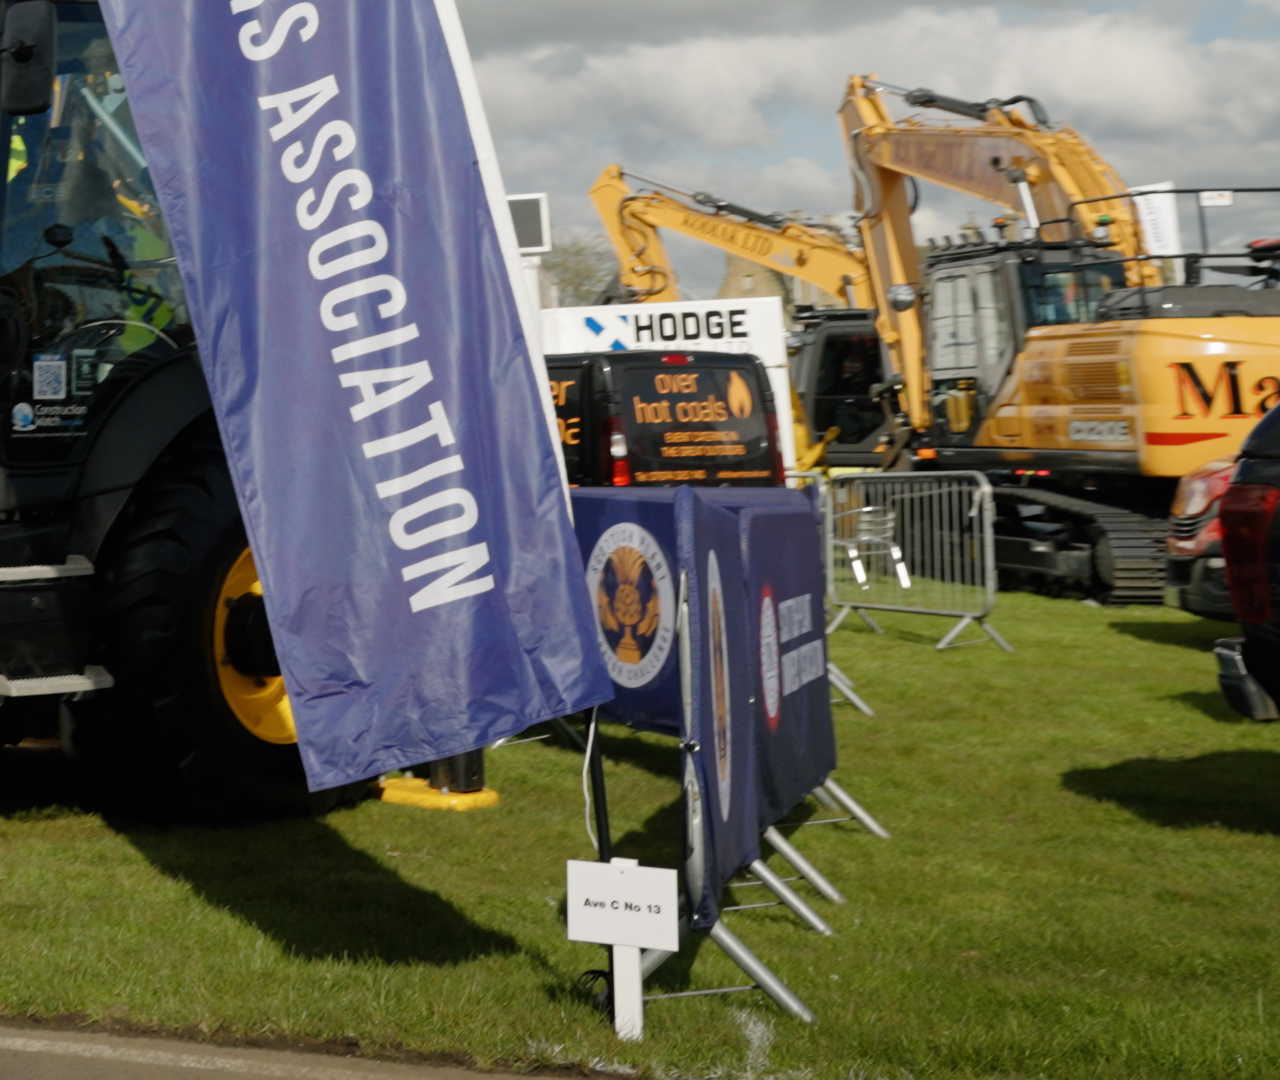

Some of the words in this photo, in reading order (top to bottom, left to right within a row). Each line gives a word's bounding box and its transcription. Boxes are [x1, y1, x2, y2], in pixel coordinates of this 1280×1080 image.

[635, 309, 748, 342] HODGE
[257, 74, 495, 613] ASSOCIATION
[654, 373, 699, 394] over
[633, 396, 672, 423] hot
[676, 395, 729, 423] coals
[583, 898, 606, 909] Ave
[610, 900, 620, 910] C
[624, 901, 641, 913] No
[646, 904, 662, 915] 13
